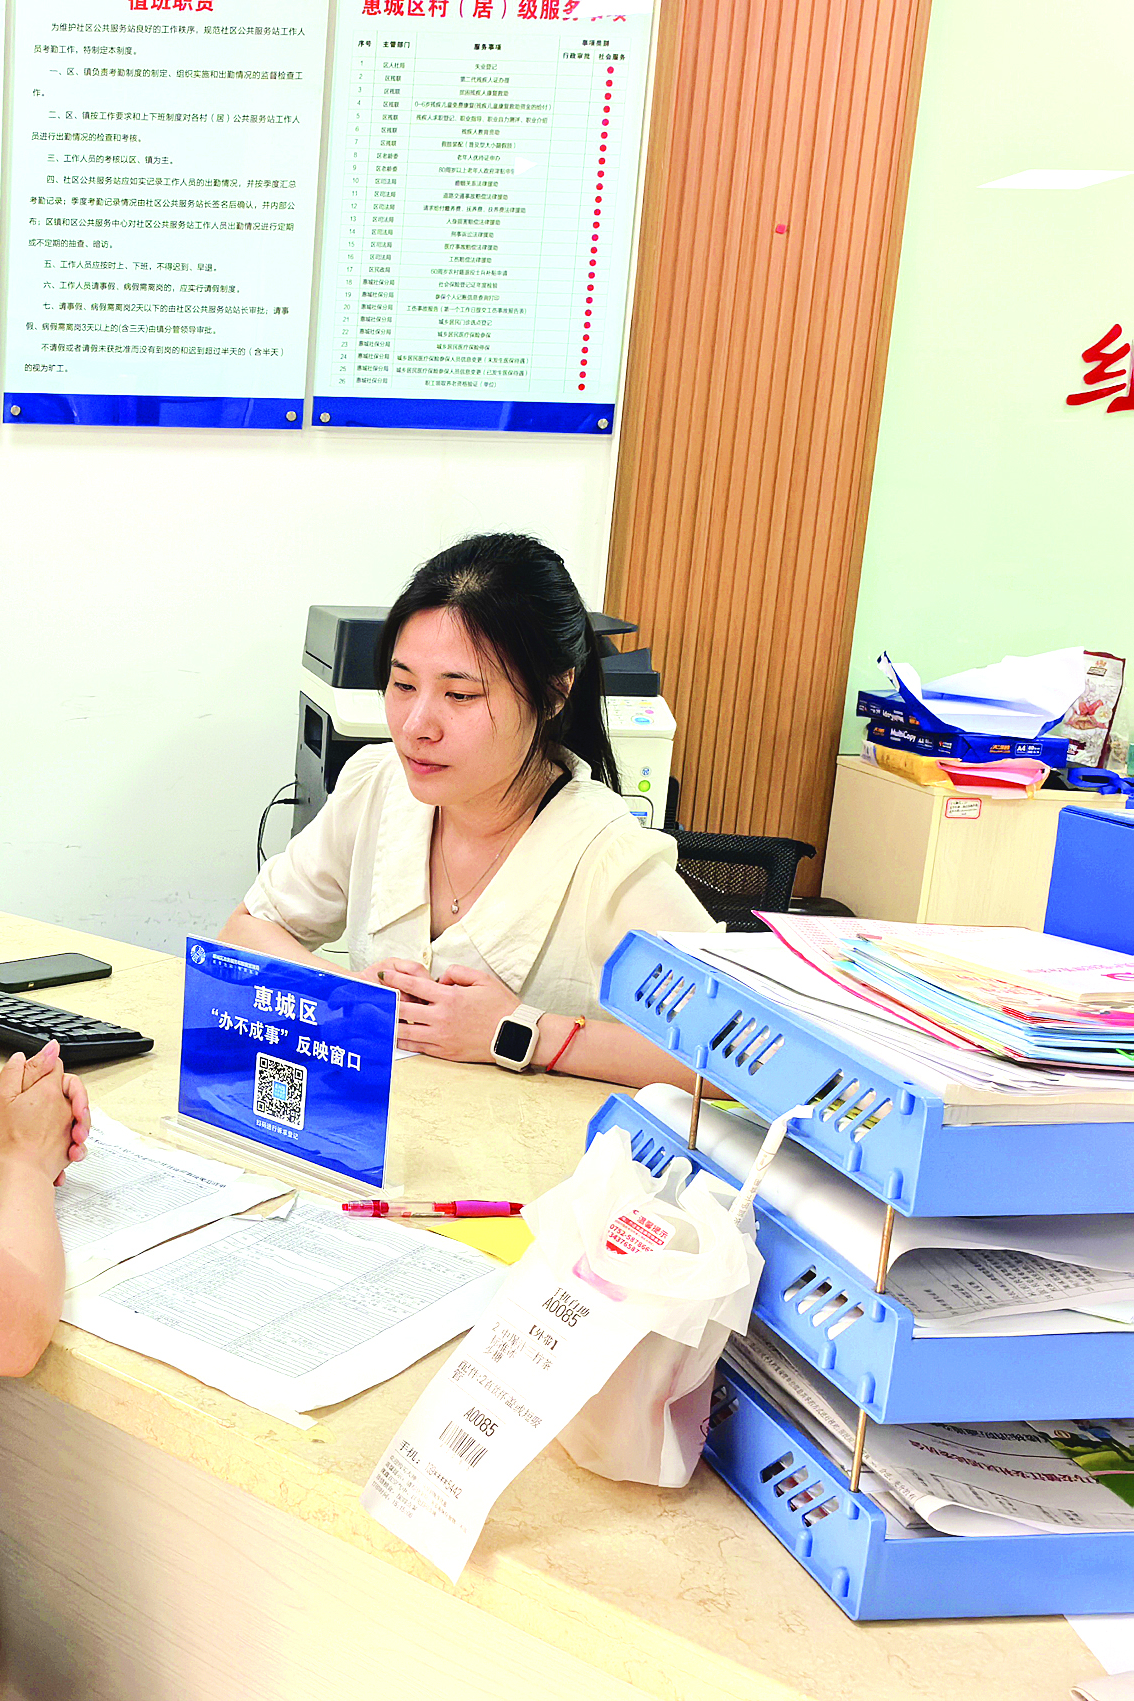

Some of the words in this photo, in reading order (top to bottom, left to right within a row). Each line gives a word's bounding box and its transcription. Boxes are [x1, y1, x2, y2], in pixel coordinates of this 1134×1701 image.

[358, 40, 371, 48] 序号
[383, 41, 411, 49] 主管部门
[474, 43, 502, 51] 服务事项
[598, 53, 625, 61] 社会服务
[890, 727, 917, 743] MultiCopy
[254, 985, 318, 1026] 惠城区
[637, 1215, 669, 1239] 温馨提示
[542, 1296, 582, 1328] A0085
[462, 1406, 499, 1438] A0085
